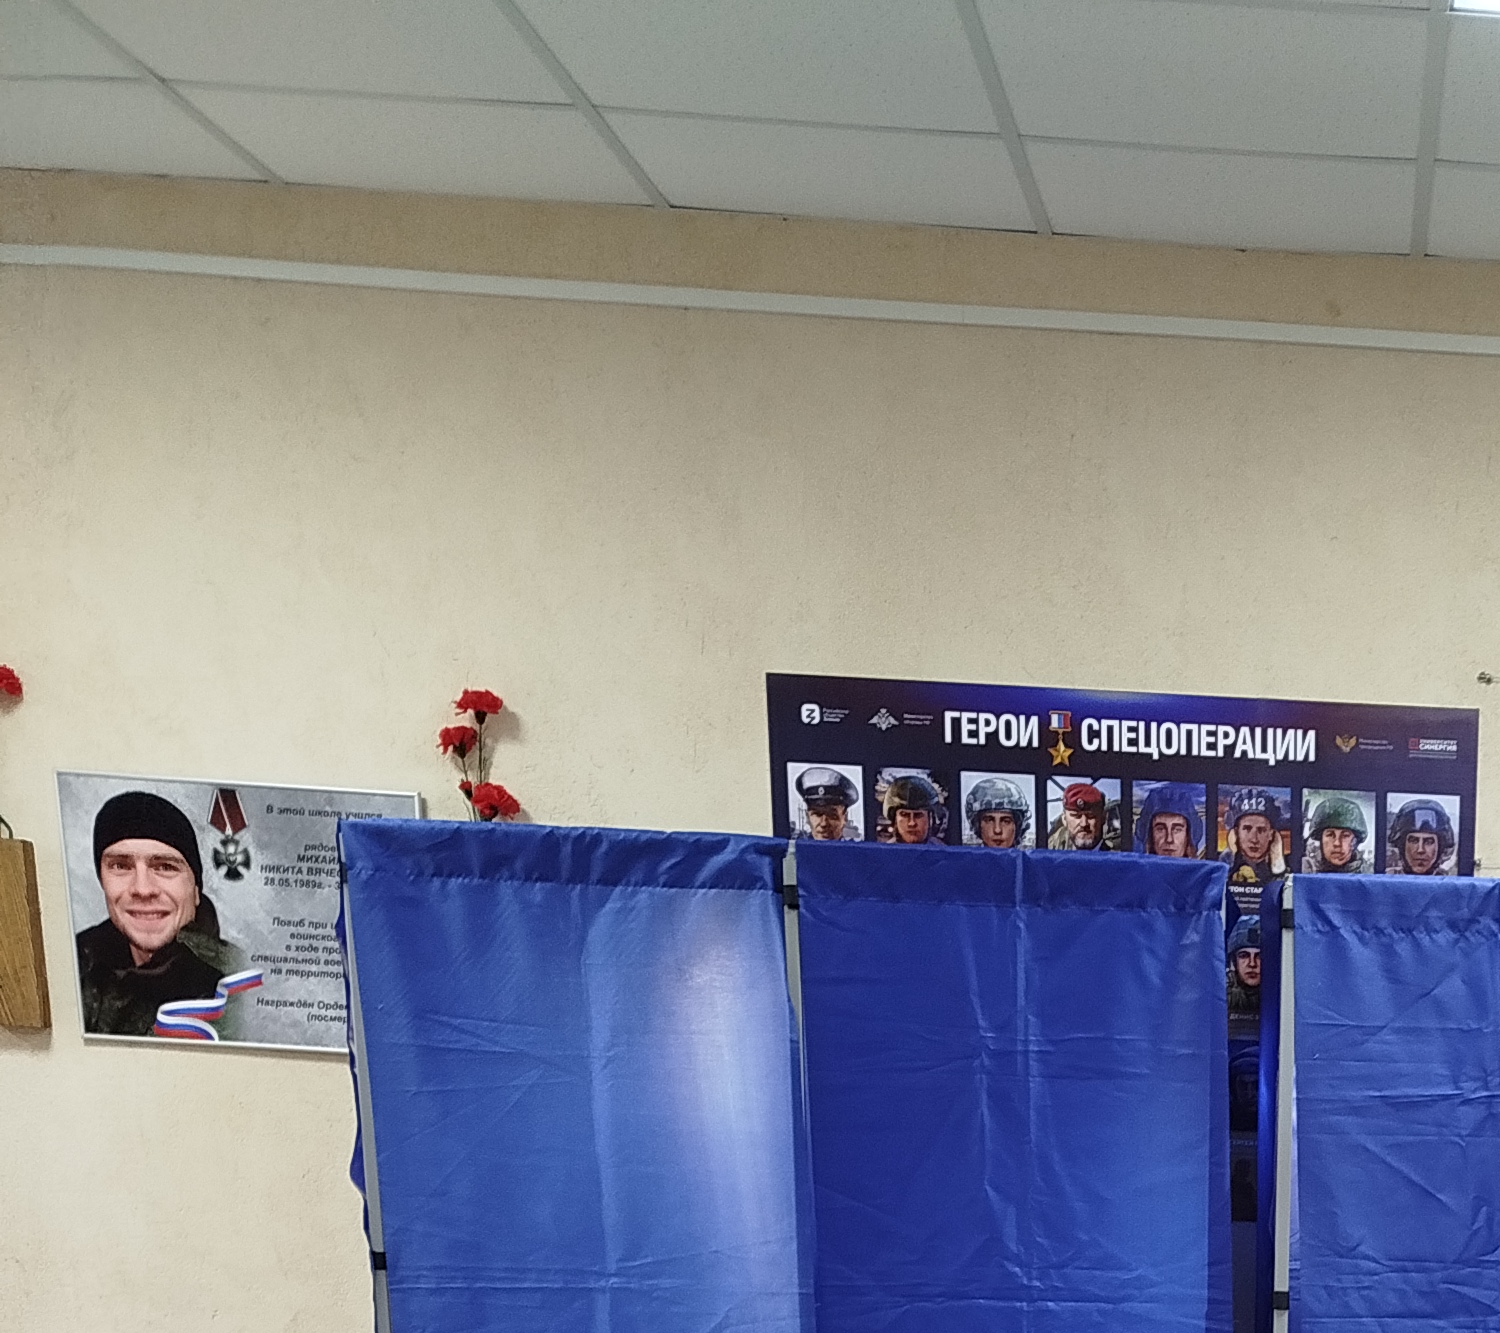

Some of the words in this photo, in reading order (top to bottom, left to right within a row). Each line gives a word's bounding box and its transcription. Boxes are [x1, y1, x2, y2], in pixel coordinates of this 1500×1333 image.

[943, 711, 1039, 748] ГЕРОИ
[1081, 717, 1317, 766] СПЕЦОПЕРАЦИИ
[266, 805, 274, 814] В
[277, 807, 305, 816] этой
[260, 864, 303, 877] НИКИТА
[272, 917, 306, 928] Погиб
[308, 920, 328, 931] при
[285, 944, 292, 952] в
[295, 944, 319, 954] ходе
[251, 955, 321, 966] специальной
[270, 968, 283, 977] на
[256, 997, 315, 1009] Награждён
